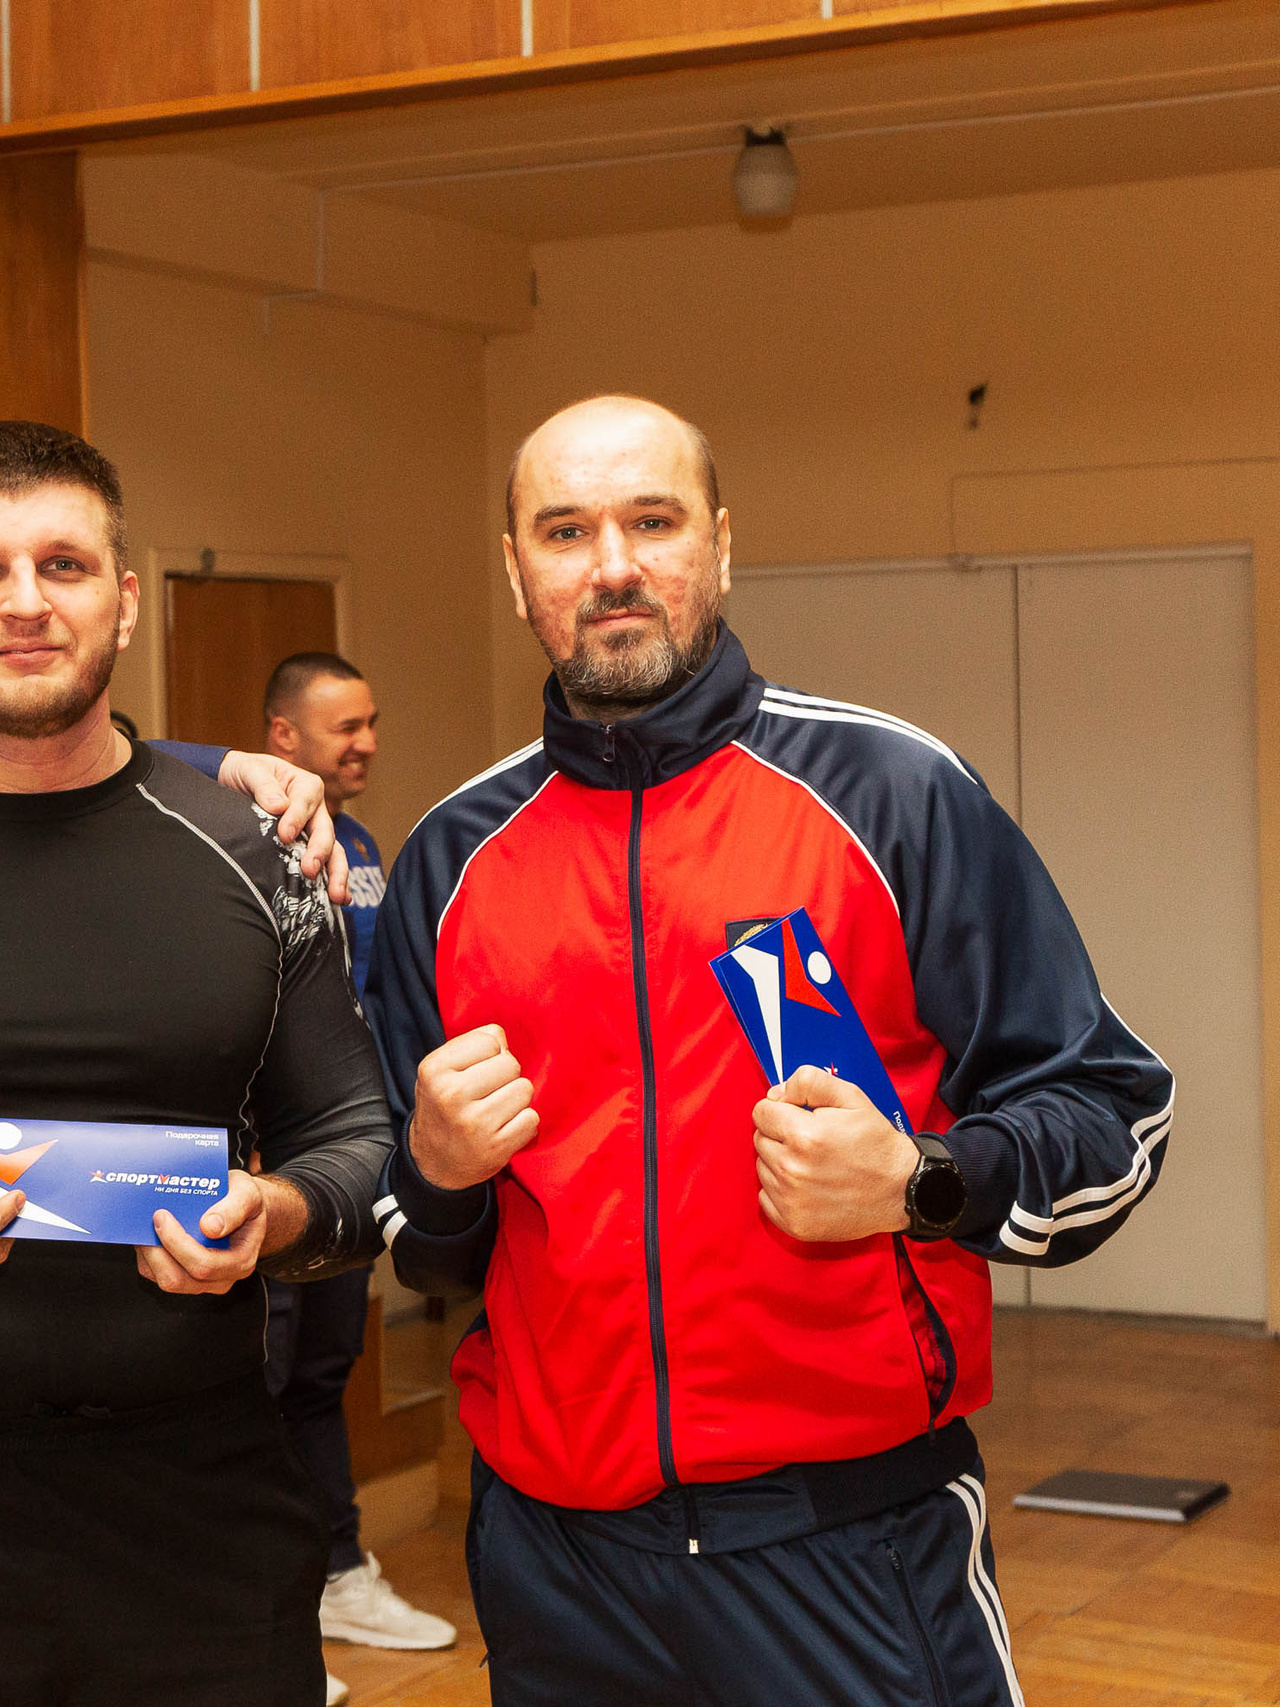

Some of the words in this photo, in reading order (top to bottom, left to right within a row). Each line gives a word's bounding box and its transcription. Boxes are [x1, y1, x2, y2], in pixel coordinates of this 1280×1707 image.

[165, 1130, 220, 1141] Подарочная
[195, 1139, 220, 1148] карта
[179, 1187, 192, 1195] БЕЗ
[192, 1188, 218, 1196] СПОРТА
